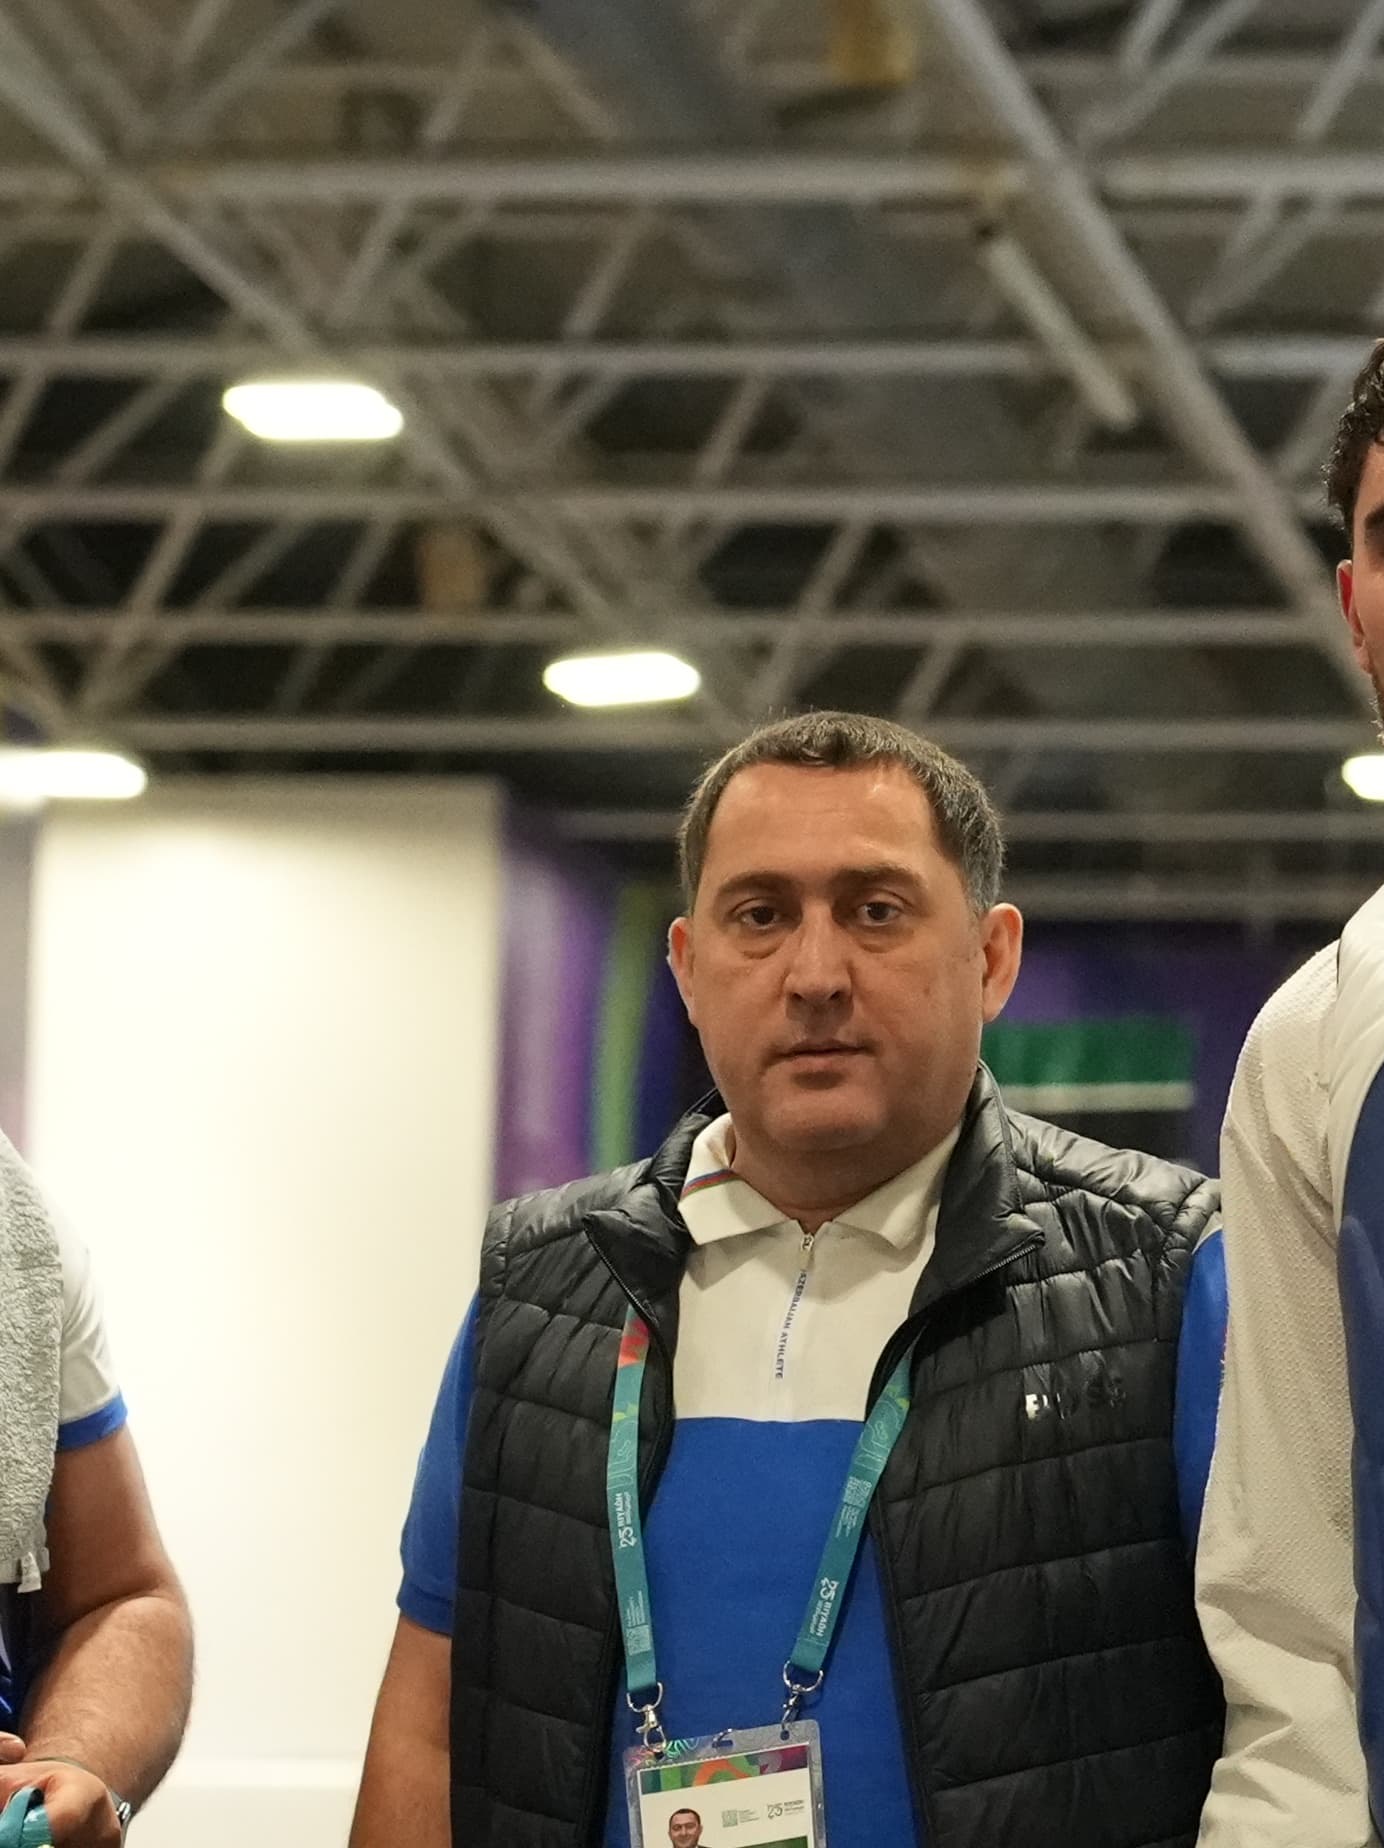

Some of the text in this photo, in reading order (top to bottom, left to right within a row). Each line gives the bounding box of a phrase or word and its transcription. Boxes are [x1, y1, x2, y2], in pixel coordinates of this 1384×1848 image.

[775, 1272, 807, 1380] AZERBAIJAN ATHLETE
[617, 1526, 638, 1549] 25
[819, 1577, 839, 1601] 25
[815, 1601, 833, 1637] RIYADH
